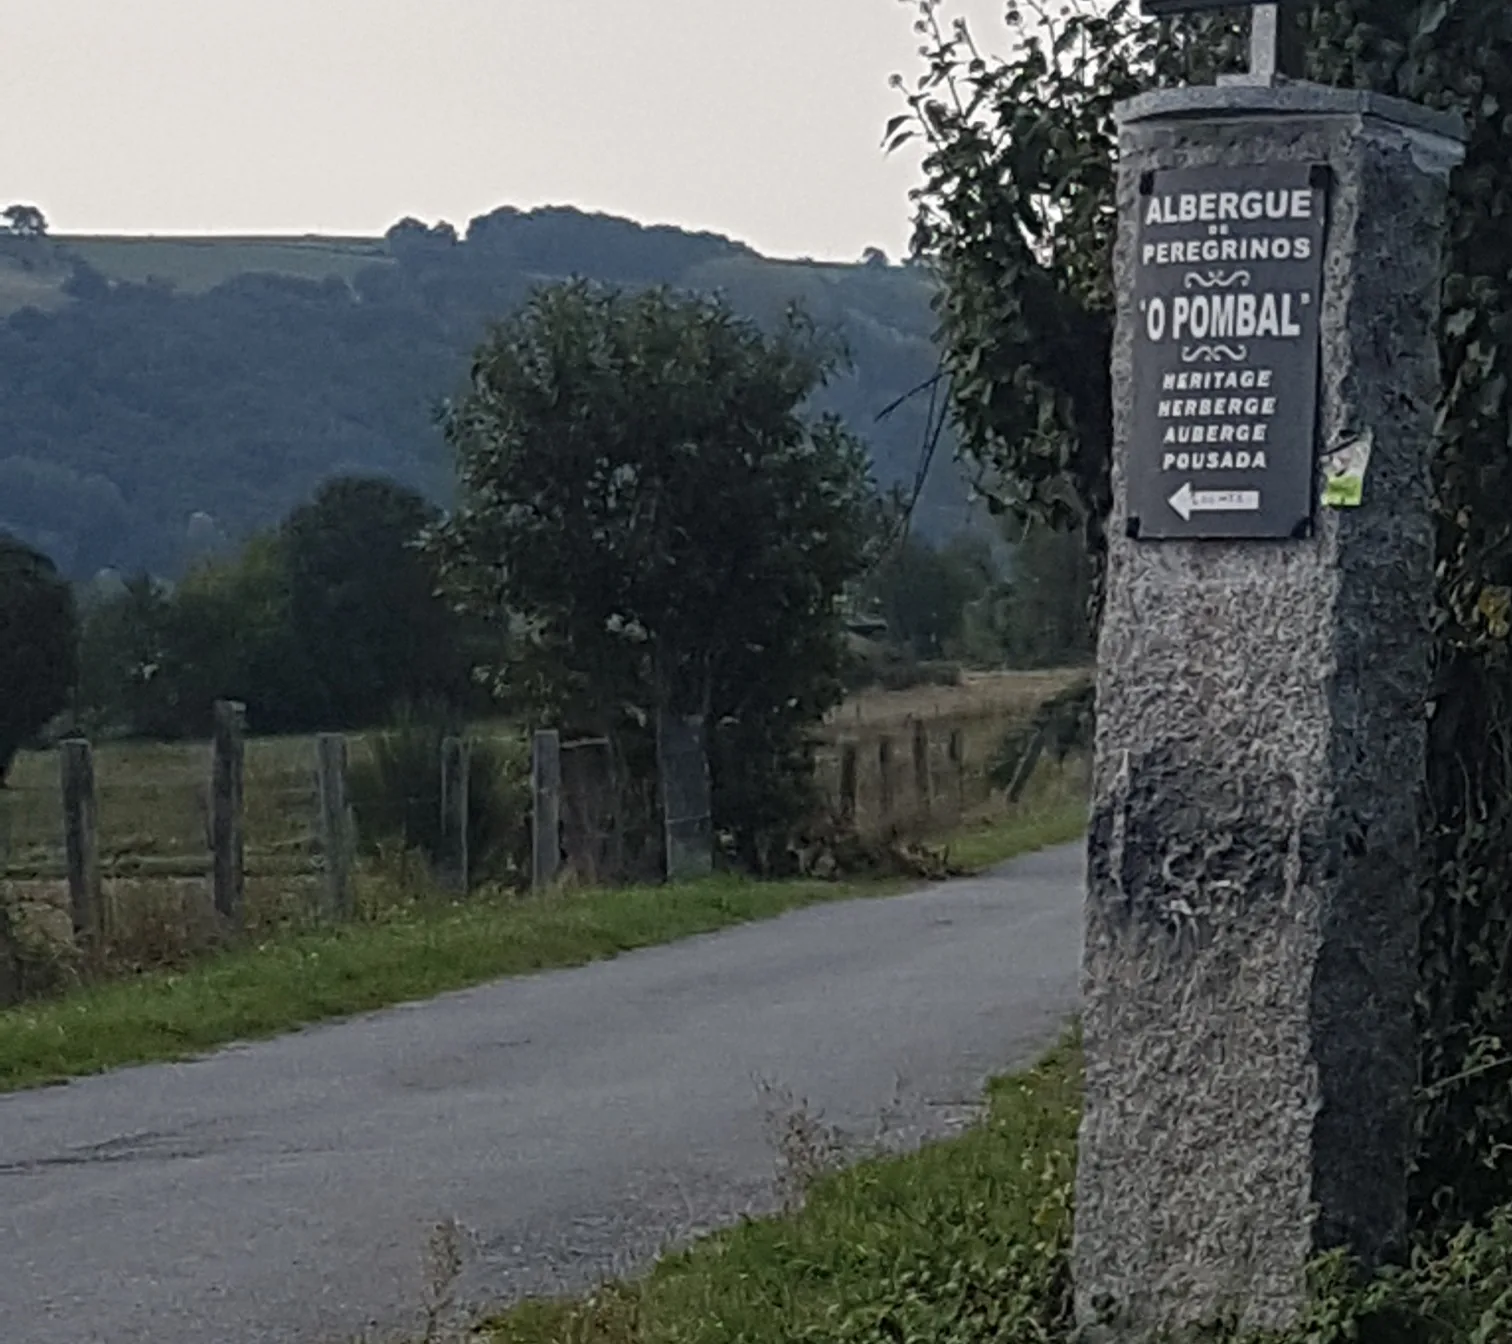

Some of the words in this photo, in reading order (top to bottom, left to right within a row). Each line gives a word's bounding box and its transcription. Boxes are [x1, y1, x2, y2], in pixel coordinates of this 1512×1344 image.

[1145, 189, 1312, 225] ALBERGUE
[1143, 238, 1311, 265] PEREGRINOS
[1162, 370, 1272, 389] HERITAGE
[1157, 397, 1276, 417] HERBERGE
[1163, 424, 1267, 443] AUBERGE
[1162, 451, 1267, 470] POUSADA
